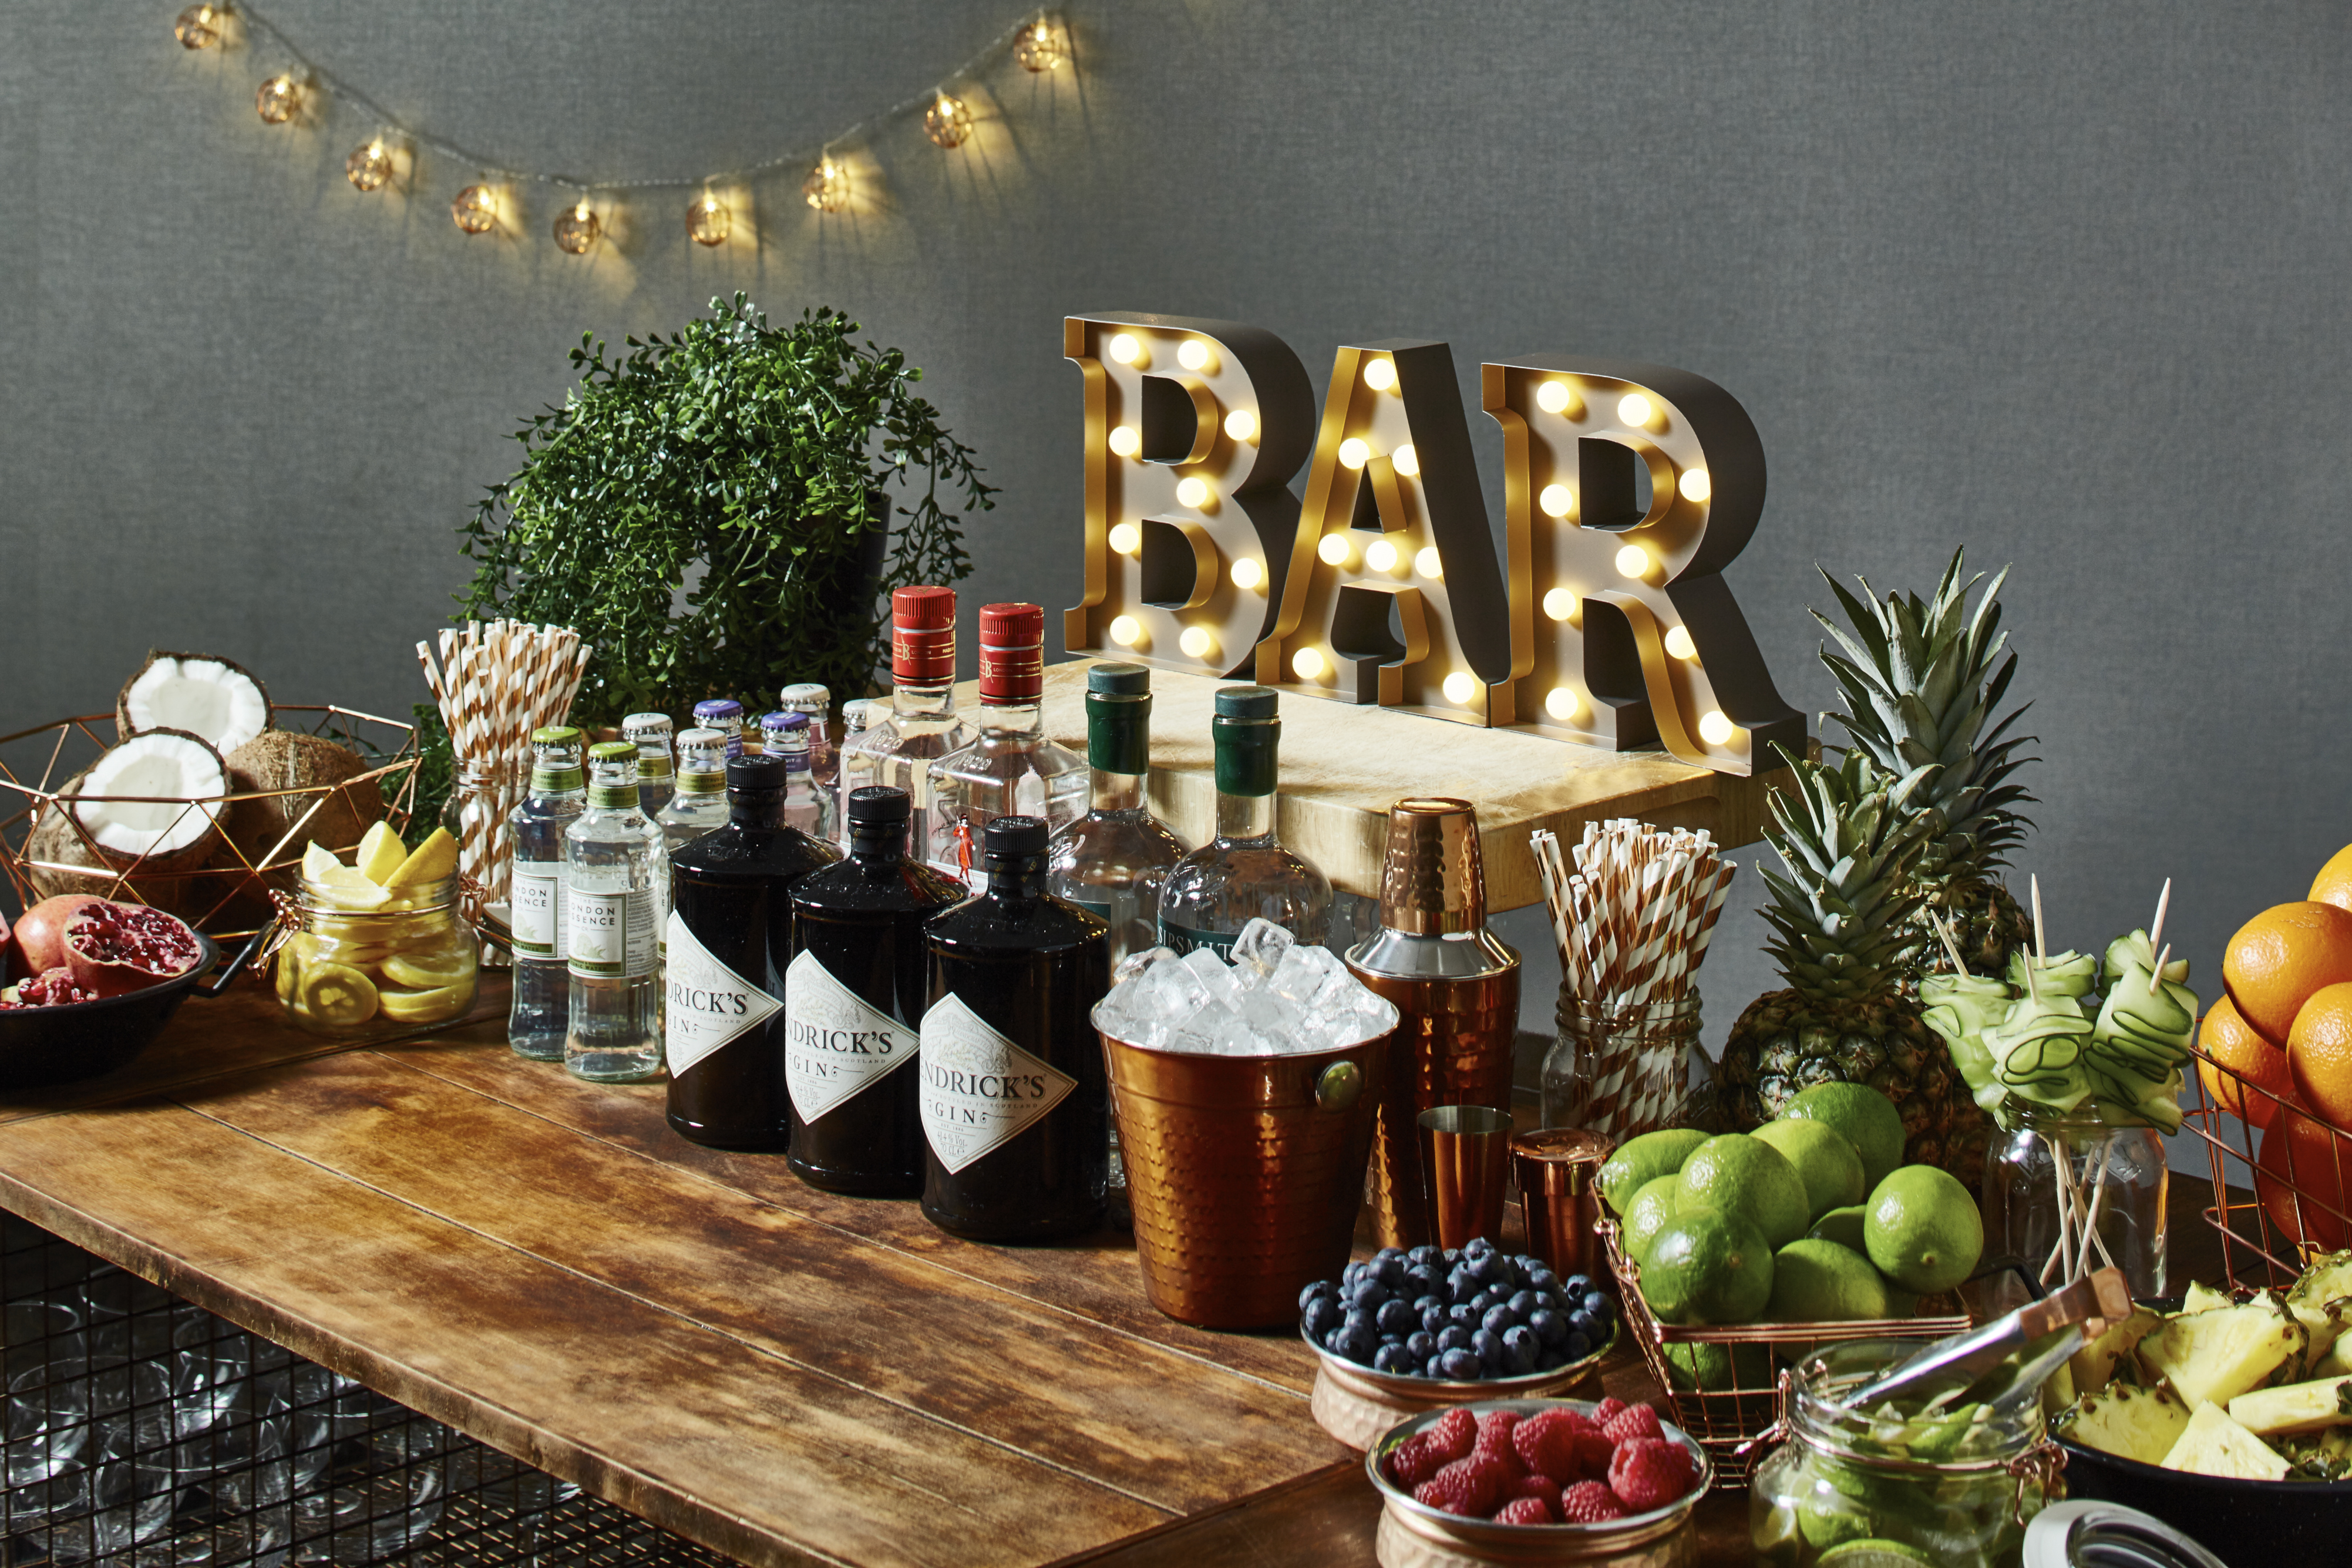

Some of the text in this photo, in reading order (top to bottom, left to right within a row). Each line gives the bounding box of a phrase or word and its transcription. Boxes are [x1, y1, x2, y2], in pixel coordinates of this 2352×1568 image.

[1064, 315, 1806, 776] BAR
[515, 894, 547, 907] SENCE
[516, 886, 547, 897] NDON
[571, 902, 615, 916] ONDON
[571, 913, 615, 926] SSENCE
[1159, 926, 1234, 960] SIPSMIT
[668, 978, 748, 1015] DRICK'S
[667, 1011, 690, 1034] GIN
[699, 1016, 741, 1024] SCOTLAND
[787, 1014, 893, 1054] NDRICK'S
[793, 1055, 827, 1078] GIN
[921, 1055, 1045, 1100] ENDRICK'S
[940, 1095, 972, 1105] BOTTLED
[935, 1101, 976, 1124] GIN
